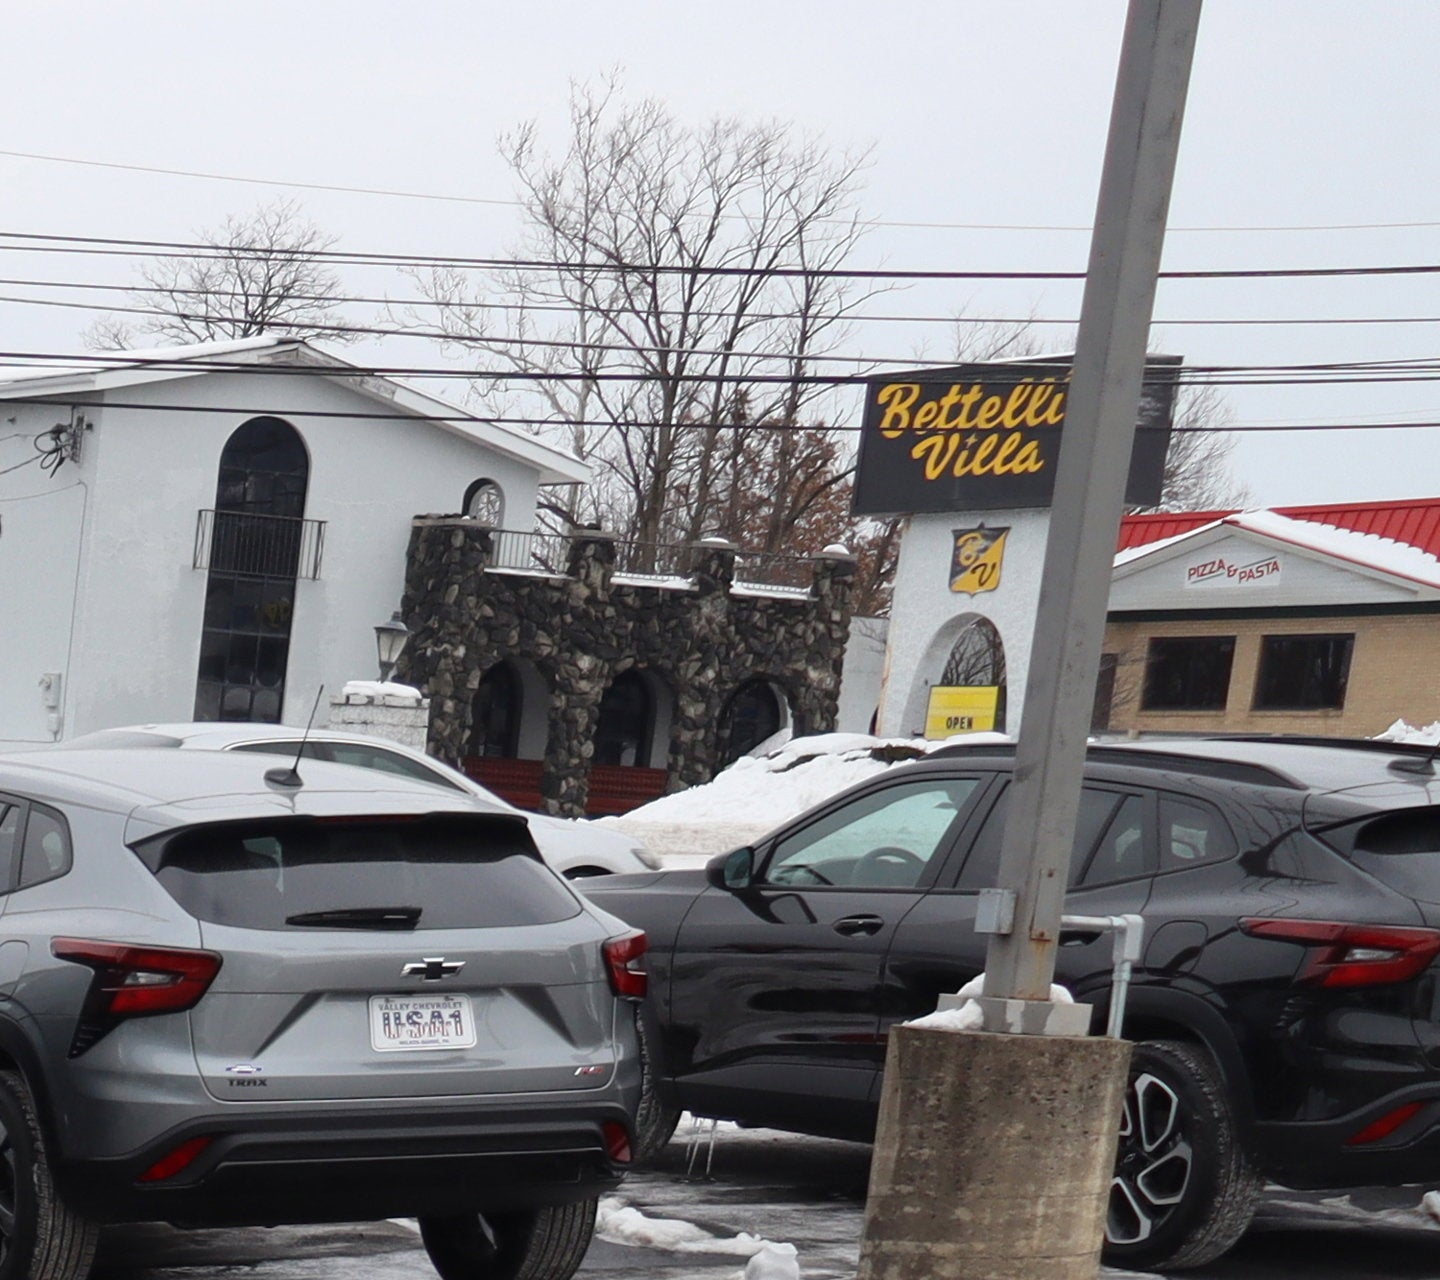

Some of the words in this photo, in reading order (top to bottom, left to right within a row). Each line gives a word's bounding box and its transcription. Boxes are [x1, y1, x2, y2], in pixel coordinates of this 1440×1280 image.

[911, 431, 1045, 480] Villa
[1188, 559, 1226, 580] PIZZA
[1227, 565, 1238, 578] &
[1239, 560, 1280, 584] PASTA
[946, 716, 974, 730] OPEN
[378, 1003, 410, 1011] VALLEY
[412, 1001, 463, 1010] CHEVROLET
[228, 1078, 268, 1087] TRAX
